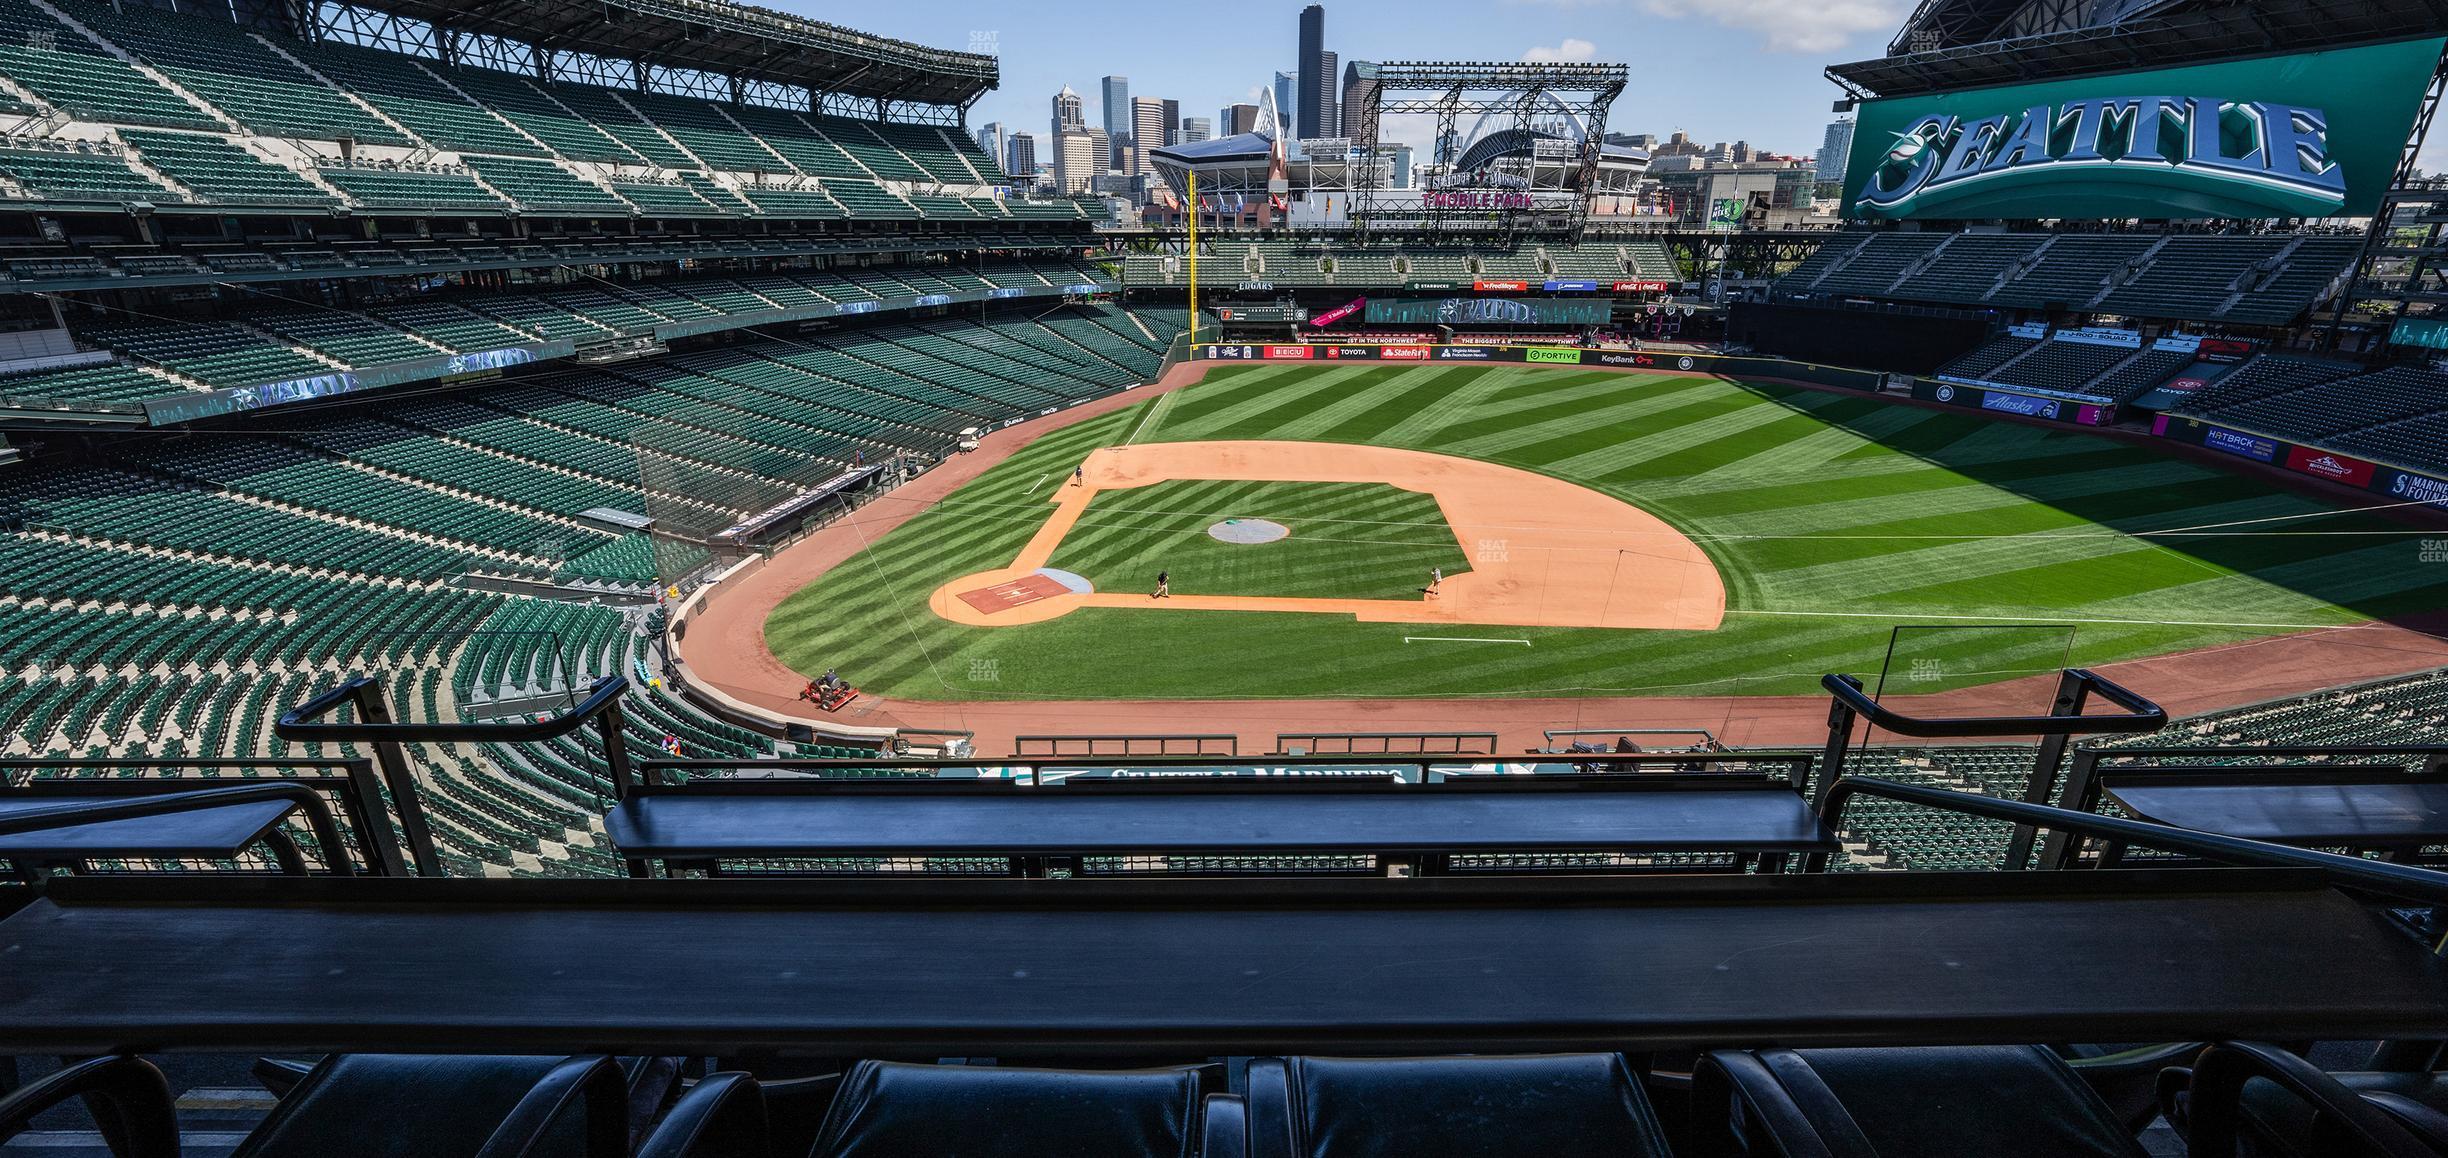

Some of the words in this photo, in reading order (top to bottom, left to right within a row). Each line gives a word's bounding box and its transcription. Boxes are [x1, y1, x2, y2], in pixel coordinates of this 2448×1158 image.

[1856, 95, 2346, 208] SEATTLE
[1422, 193, 1492, 207] T-MOBILE
[1494, 193, 1534, 207] PARK
[1239, 282, 1273, 290] EDGARS
[1275, 348, 1303, 356] BECU
[1601, 355, 1635, 364] KeyBank
[1985, 396, 2033, 412] Alaska
[2208, 430, 2255, 448] HATBACK
[2309, 463, 2343, 475] MUCKLESHOOT
[2406, 486, 2448, 506] FOUND
